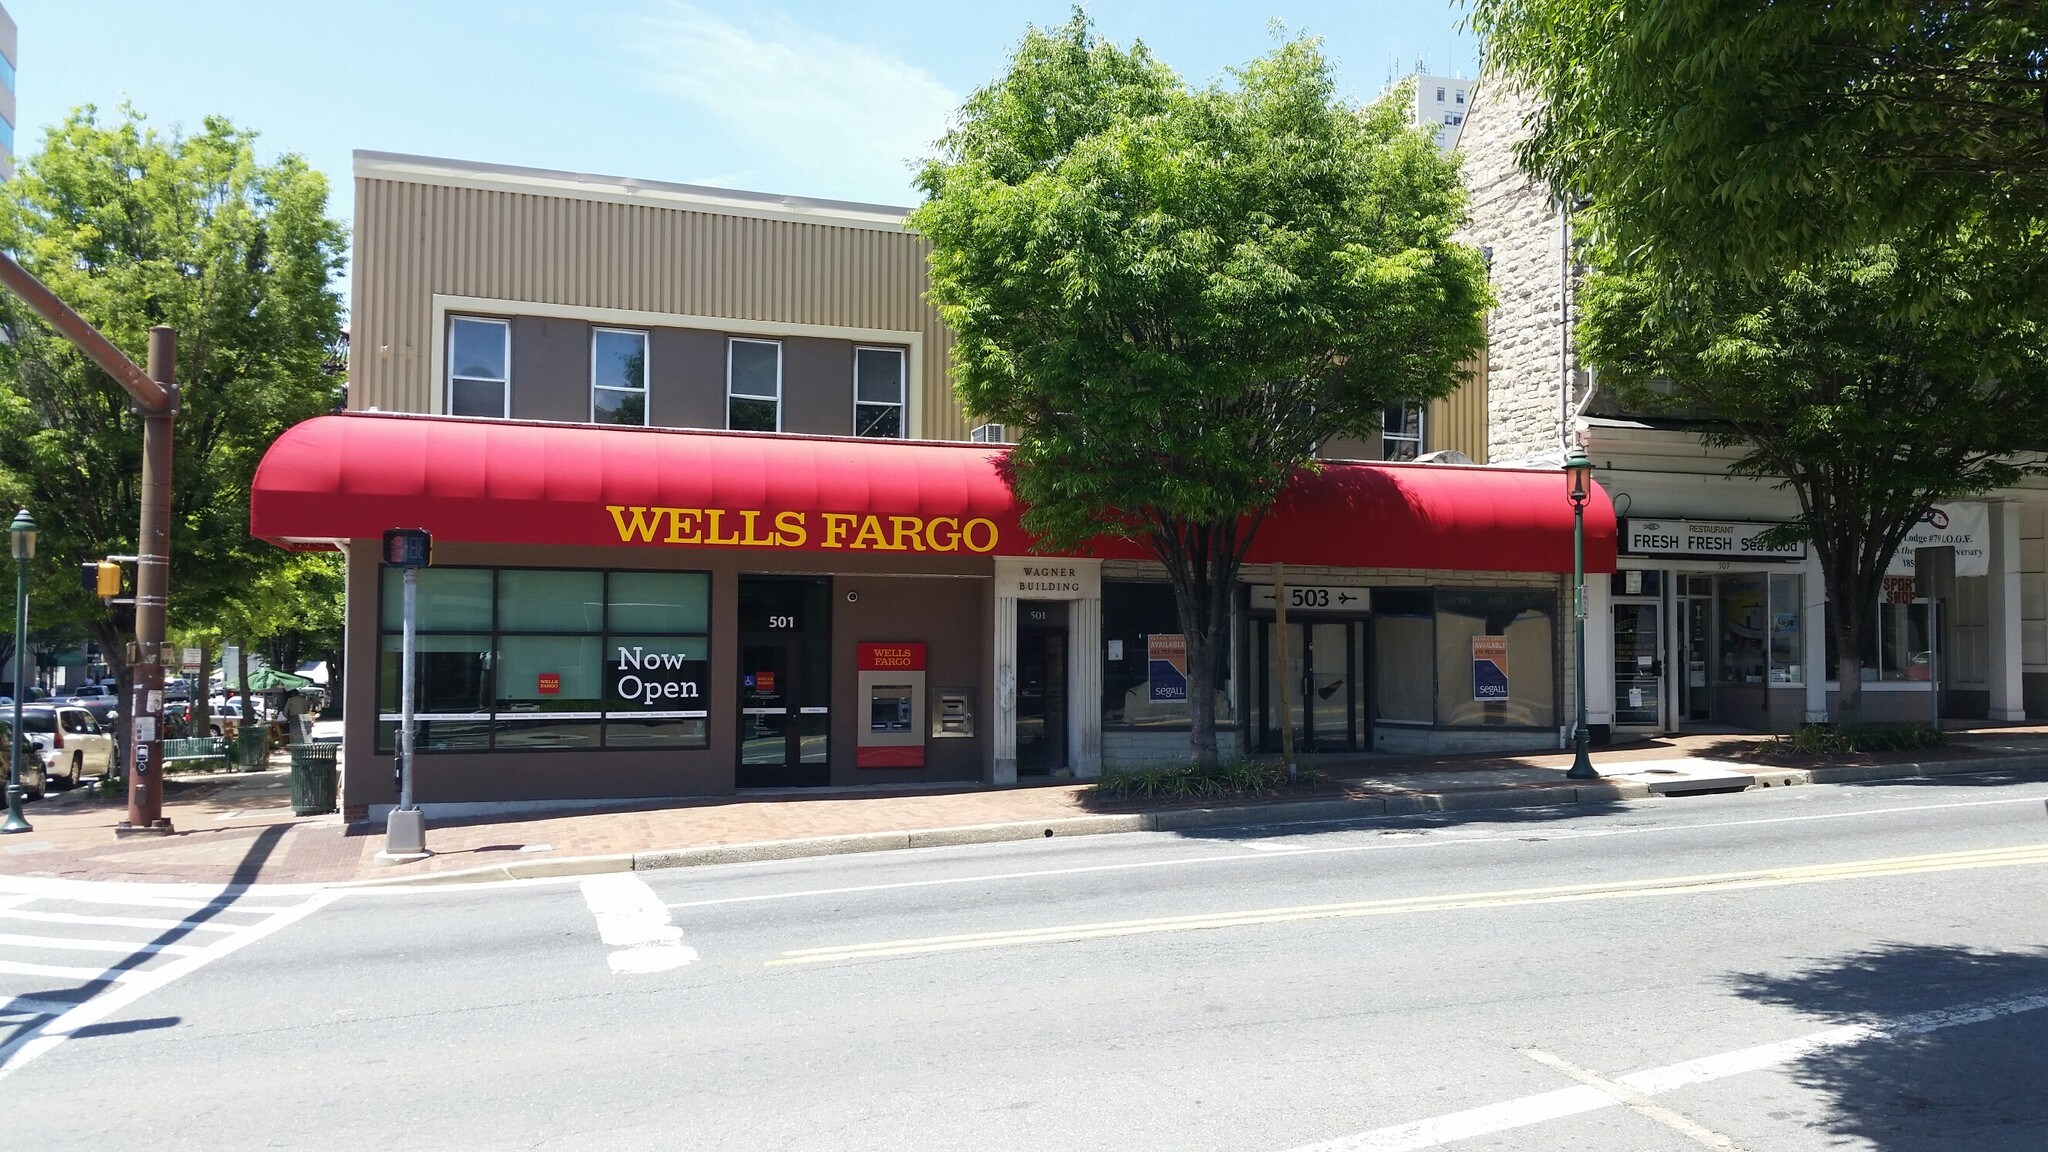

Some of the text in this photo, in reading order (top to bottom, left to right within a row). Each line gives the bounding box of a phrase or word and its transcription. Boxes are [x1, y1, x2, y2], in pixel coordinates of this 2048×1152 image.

[605, 505, 999, 552] WELLS FARGO
[1689, 525, 1734, 534] RESTAURANT
[1634, 534, 1797, 552] FRESH FRESH Seaood
[1904, 534, 1927, 544] Lodge
[1902, 547, 1915, 555] the
[1956, 548, 1983, 557] versary
[1718, 562, 1730, 570] 507
[1023, 567, 1076, 577] WAGNER
[1019, 581, 1080, 591] BUILDING
[1291, 589, 1330, 607] 503
[1886, 591, 1915, 604] SHOP
[1030, 611, 1047, 620] 501
[768, 616, 795, 628] 501
[618, 646, 686, 670] Now
[874, 649, 911, 657] WELLS
[874, 658, 911, 666] FARGO
[618, 675, 699, 705] Open
